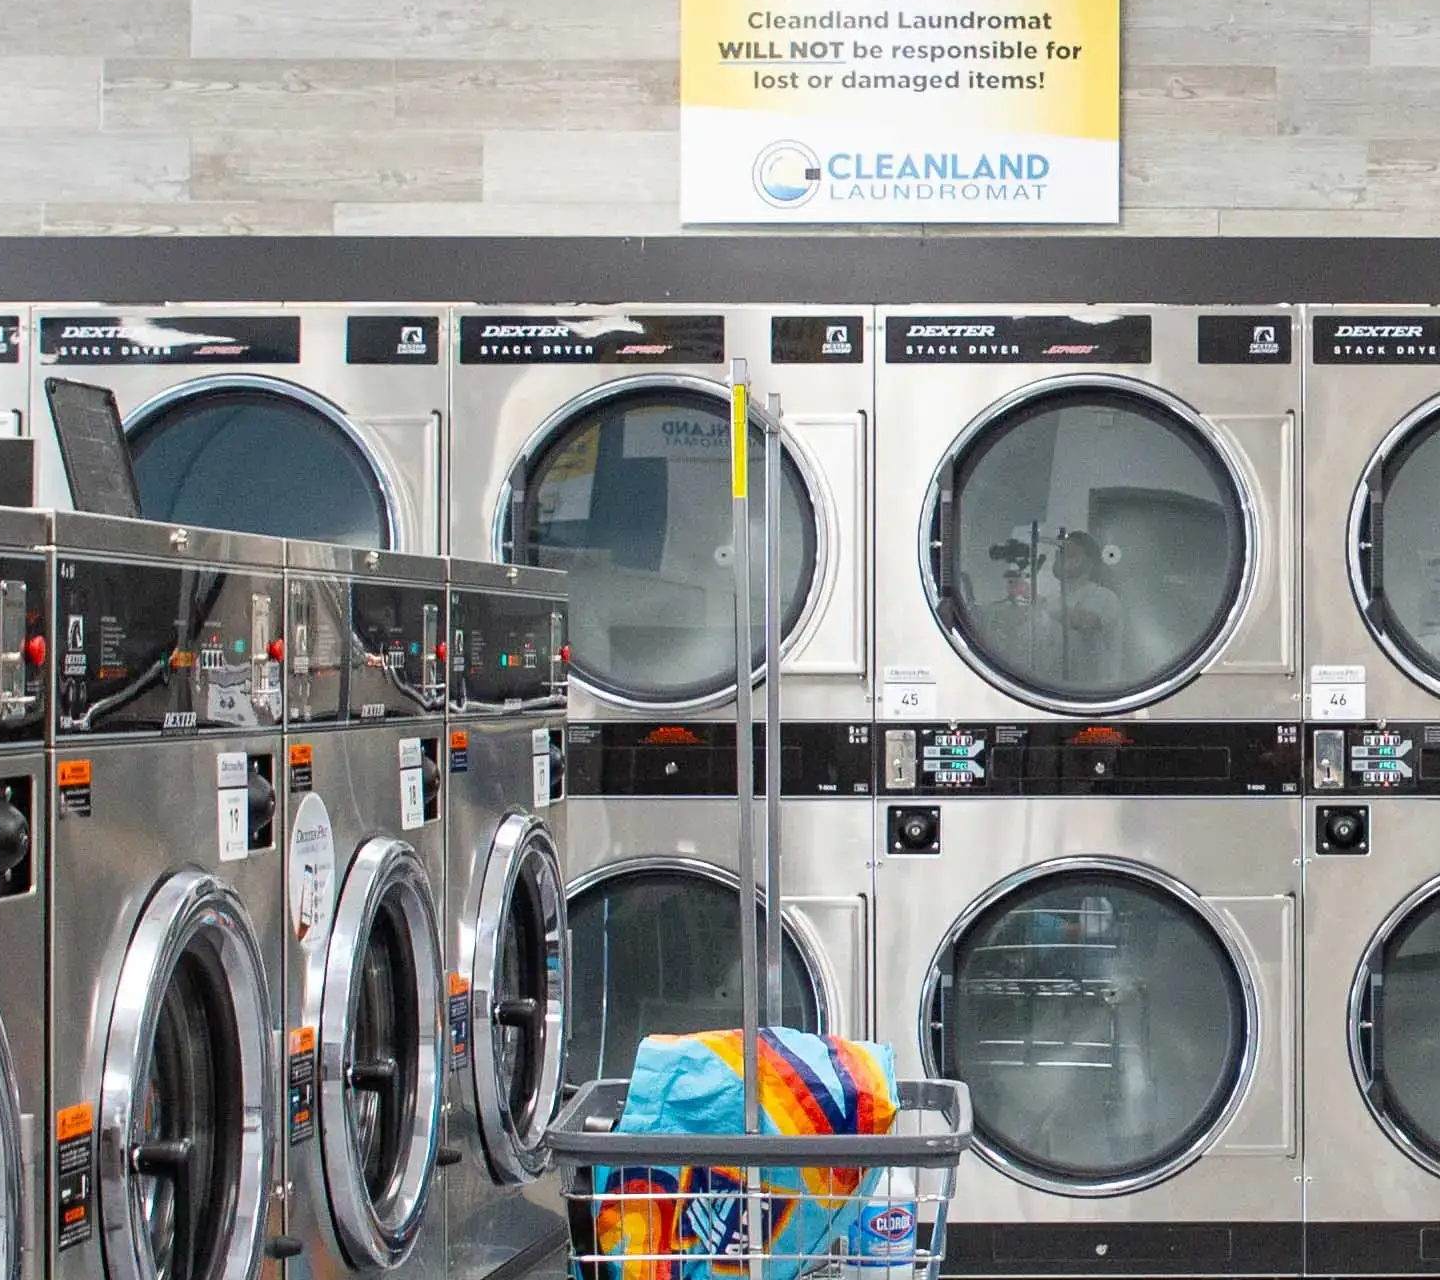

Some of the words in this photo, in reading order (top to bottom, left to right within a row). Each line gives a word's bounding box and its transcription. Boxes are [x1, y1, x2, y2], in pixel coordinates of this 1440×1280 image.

[748, 11, 889, 30] Cleandland
[898, 11, 1052, 30] Laundromat
[718, 42, 782, 59] WILL
[790, 42, 844, 59] NOT
[853, 41, 883, 60] be
[891, 41, 1038, 65] responsible
[1046, 41, 1082, 60] for
[753, 71, 799, 90] lost
[807, 75, 833, 90] or
[841, 71, 960, 94] damaged
[968, 71, 1046, 90] items!
[828, 153, 1050, 180] CLEANLAND
[830, 184, 1048, 201] LAUNDROMAT
[481, 325, 570, 337] DEXTER
[906, 325, 995, 337] DEXTER
[1334, 326, 1423, 337] DEXTER
[60, 346, 111, 356] STACK
[481, 345, 533, 355] STACK
[543, 345, 594, 355] DRYER
[906, 345, 958, 355] STACK
[969, 345, 1020, 354] DRYER
[1334, 345, 1386, 355] STACK
[901, 693, 919, 706] 45
[1330, 693, 1347, 706] 46
[163, 712, 197, 728] DEXTER
